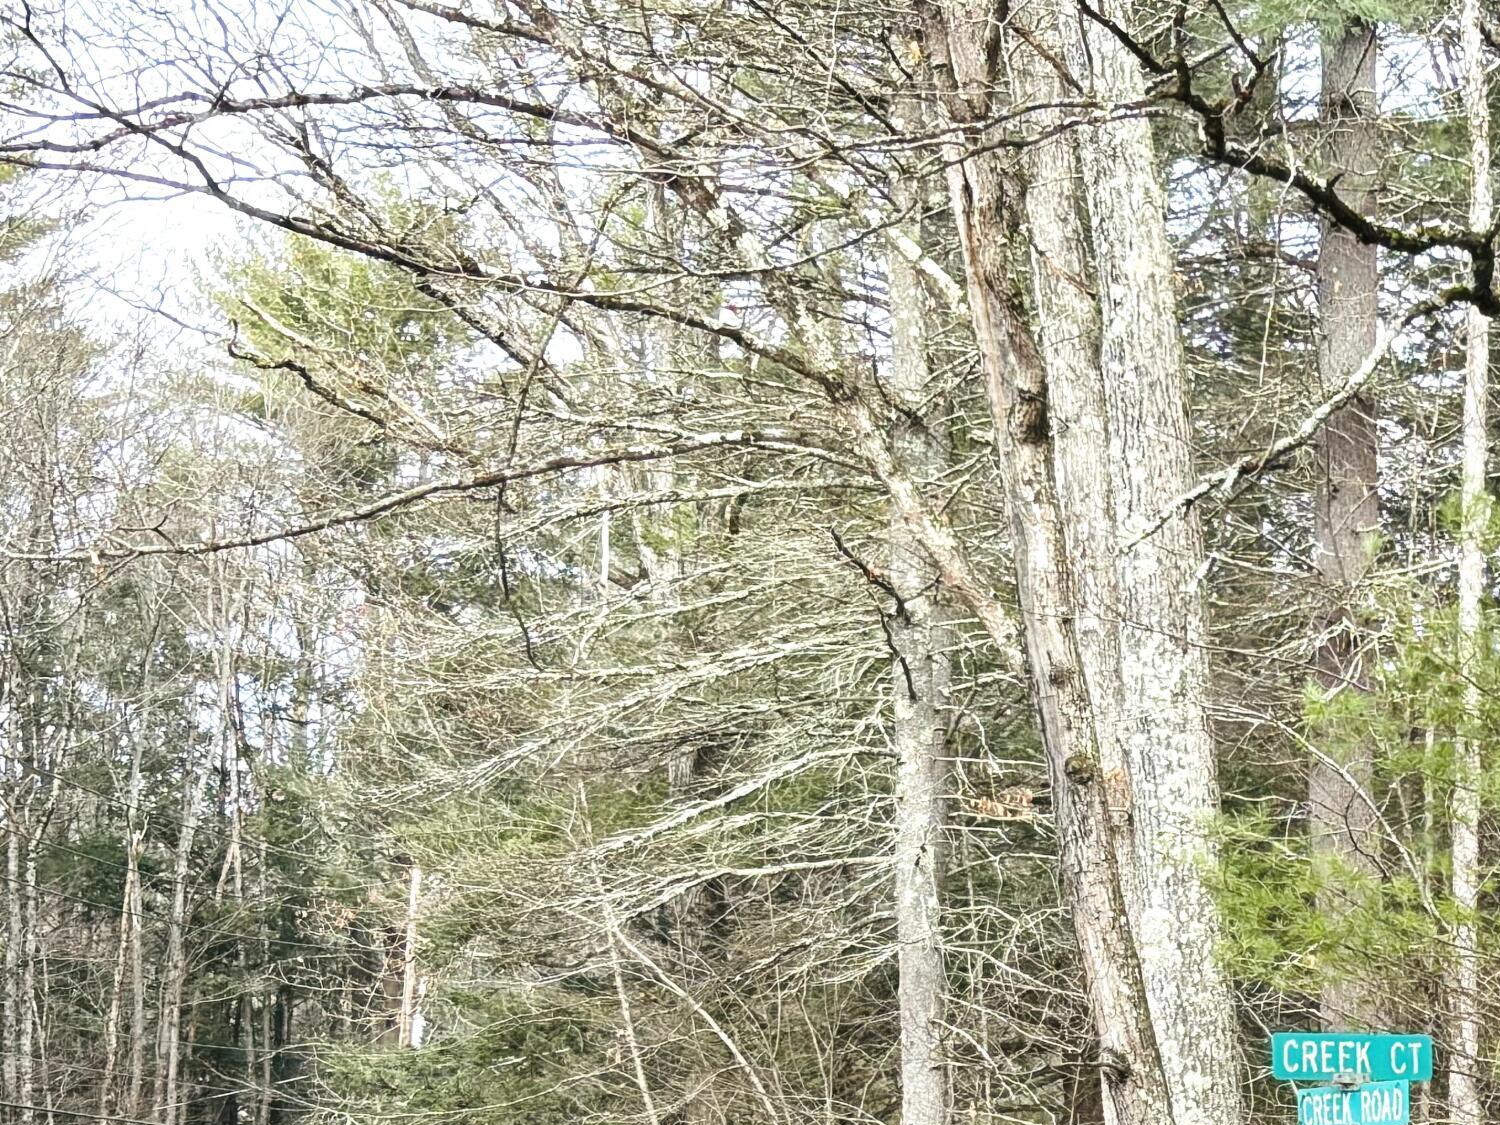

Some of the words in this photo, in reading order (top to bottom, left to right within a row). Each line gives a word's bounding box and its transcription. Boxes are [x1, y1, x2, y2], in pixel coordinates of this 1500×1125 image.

[1283, 1039, 1371, 1073] CREEK
[1390, 1042, 1422, 1074] CT
[1360, 1087, 1403, 1123] ROAD
